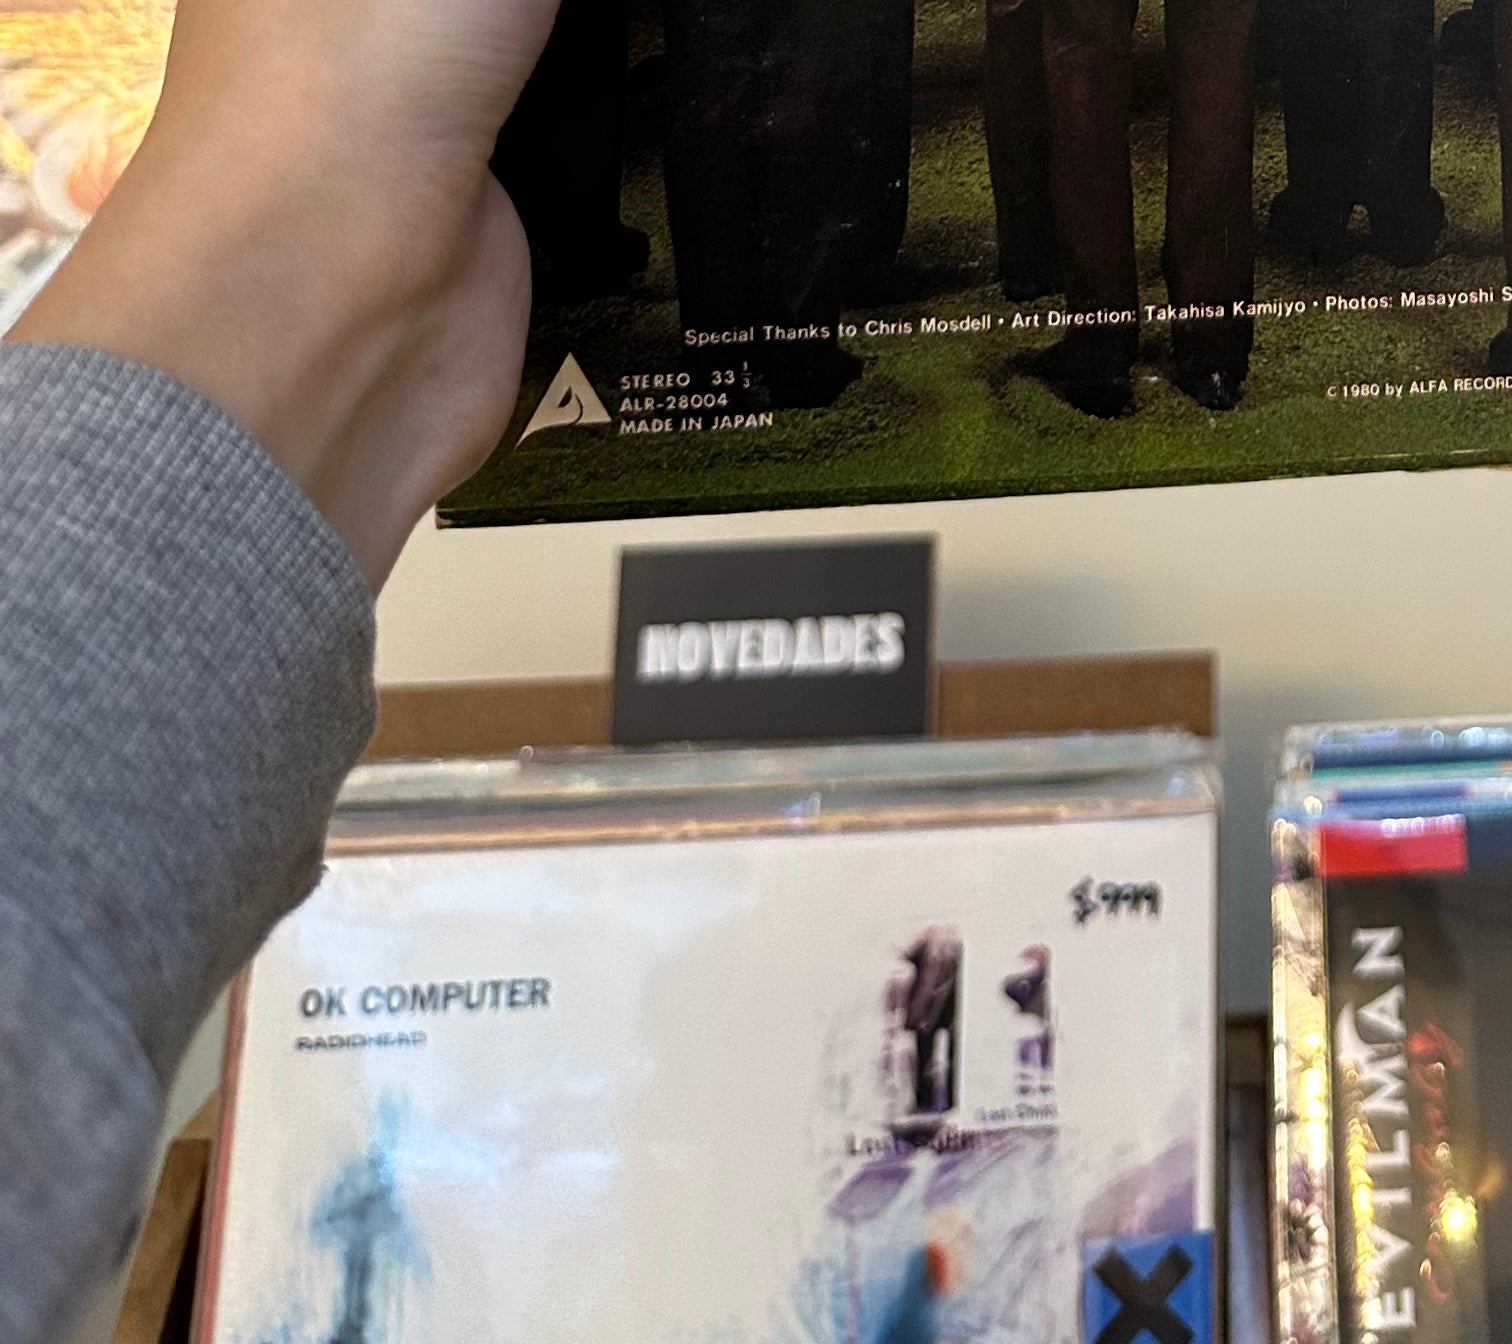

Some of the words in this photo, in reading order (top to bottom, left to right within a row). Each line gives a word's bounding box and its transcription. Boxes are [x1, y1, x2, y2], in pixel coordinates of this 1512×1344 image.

[684, 325, 754, 346] Special
[763, 324, 830, 342] Thanks
[838, 323, 857, 337] to
[865, 318, 913, 337] Chris
[920, 315, 992, 334] Mosdell
[1011, 312, 1040, 329] Art
[1047, 307, 1137, 328] Direction:
[1144, 303, 1225, 322] Takahisa
[1325, 295, 1393, 312] Photos:
[1400, 287, 1495, 309] Masayoshi
[619, 372, 691, 390] STEREO
[1342, 383, 1380, 398] 1980
[1385, 382, 1403, 398] by
[1409, 381, 1449, 395] ALFA
[619, 392, 729, 413] ALR-28004
[618, 418, 674, 435] MADE
[679, 416, 703, 433] IN
[710, 412, 774, 431] JAPAN
[638, 613, 905, 678] NOVEDADES
[1070, 876, 1162, 924] $999
[300, 985, 347, 1019] OK
[359, 975, 551, 1015] COMPUTER
[295, 1029, 428, 1052] RADIOHEAD
